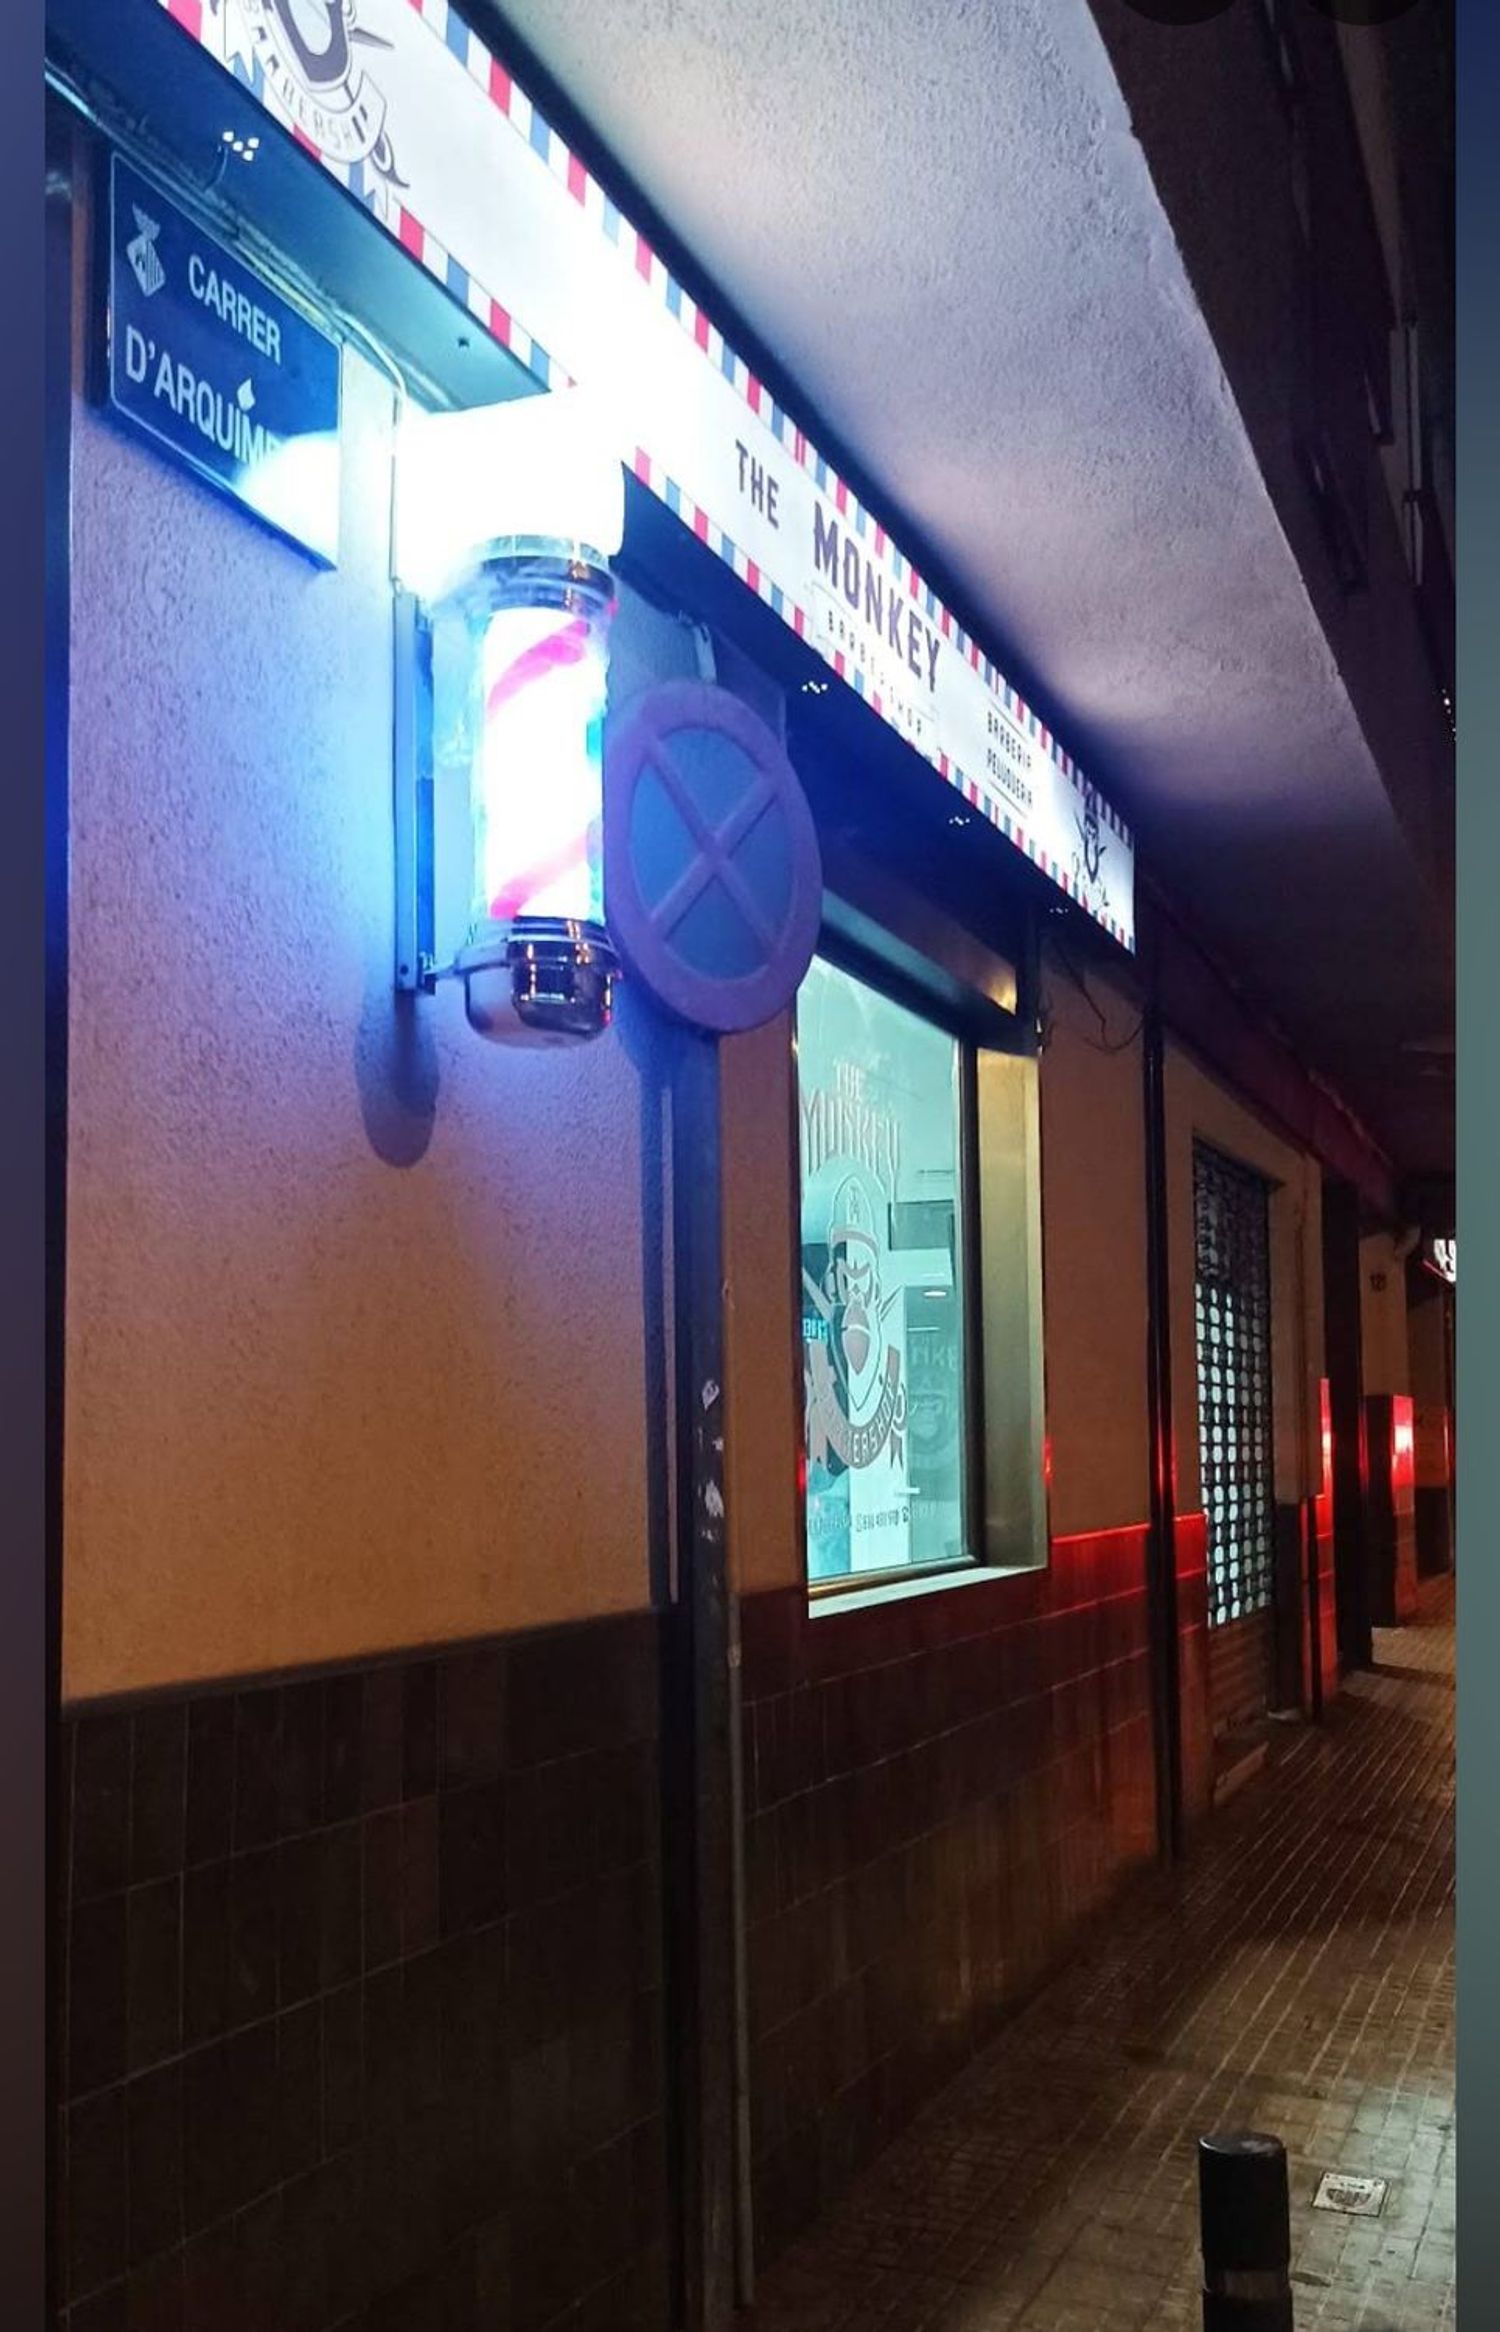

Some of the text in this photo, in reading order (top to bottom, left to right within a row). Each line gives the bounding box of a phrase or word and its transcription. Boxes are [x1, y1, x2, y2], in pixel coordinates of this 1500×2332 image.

[188, 254, 281, 365] CARRER
[735, 438, 940, 693] THE MONKEY
